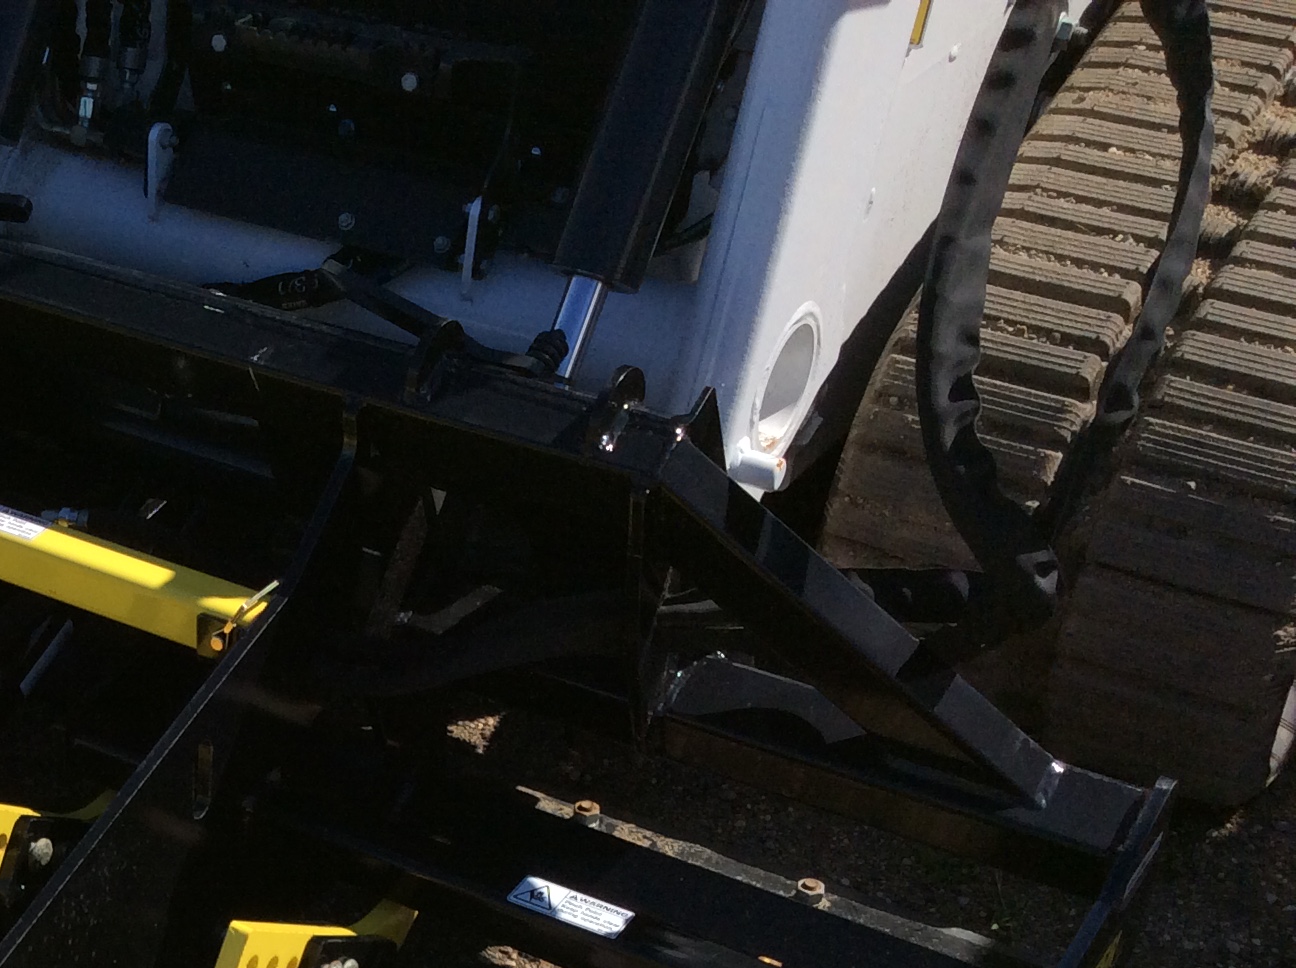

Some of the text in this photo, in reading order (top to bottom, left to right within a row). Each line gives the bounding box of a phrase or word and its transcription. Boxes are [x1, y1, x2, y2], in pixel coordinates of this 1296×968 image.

[559, 903, 579, 913] Keep
[579, 910, 601, 921] hands
[578, 896, 629, 918] WARNING
